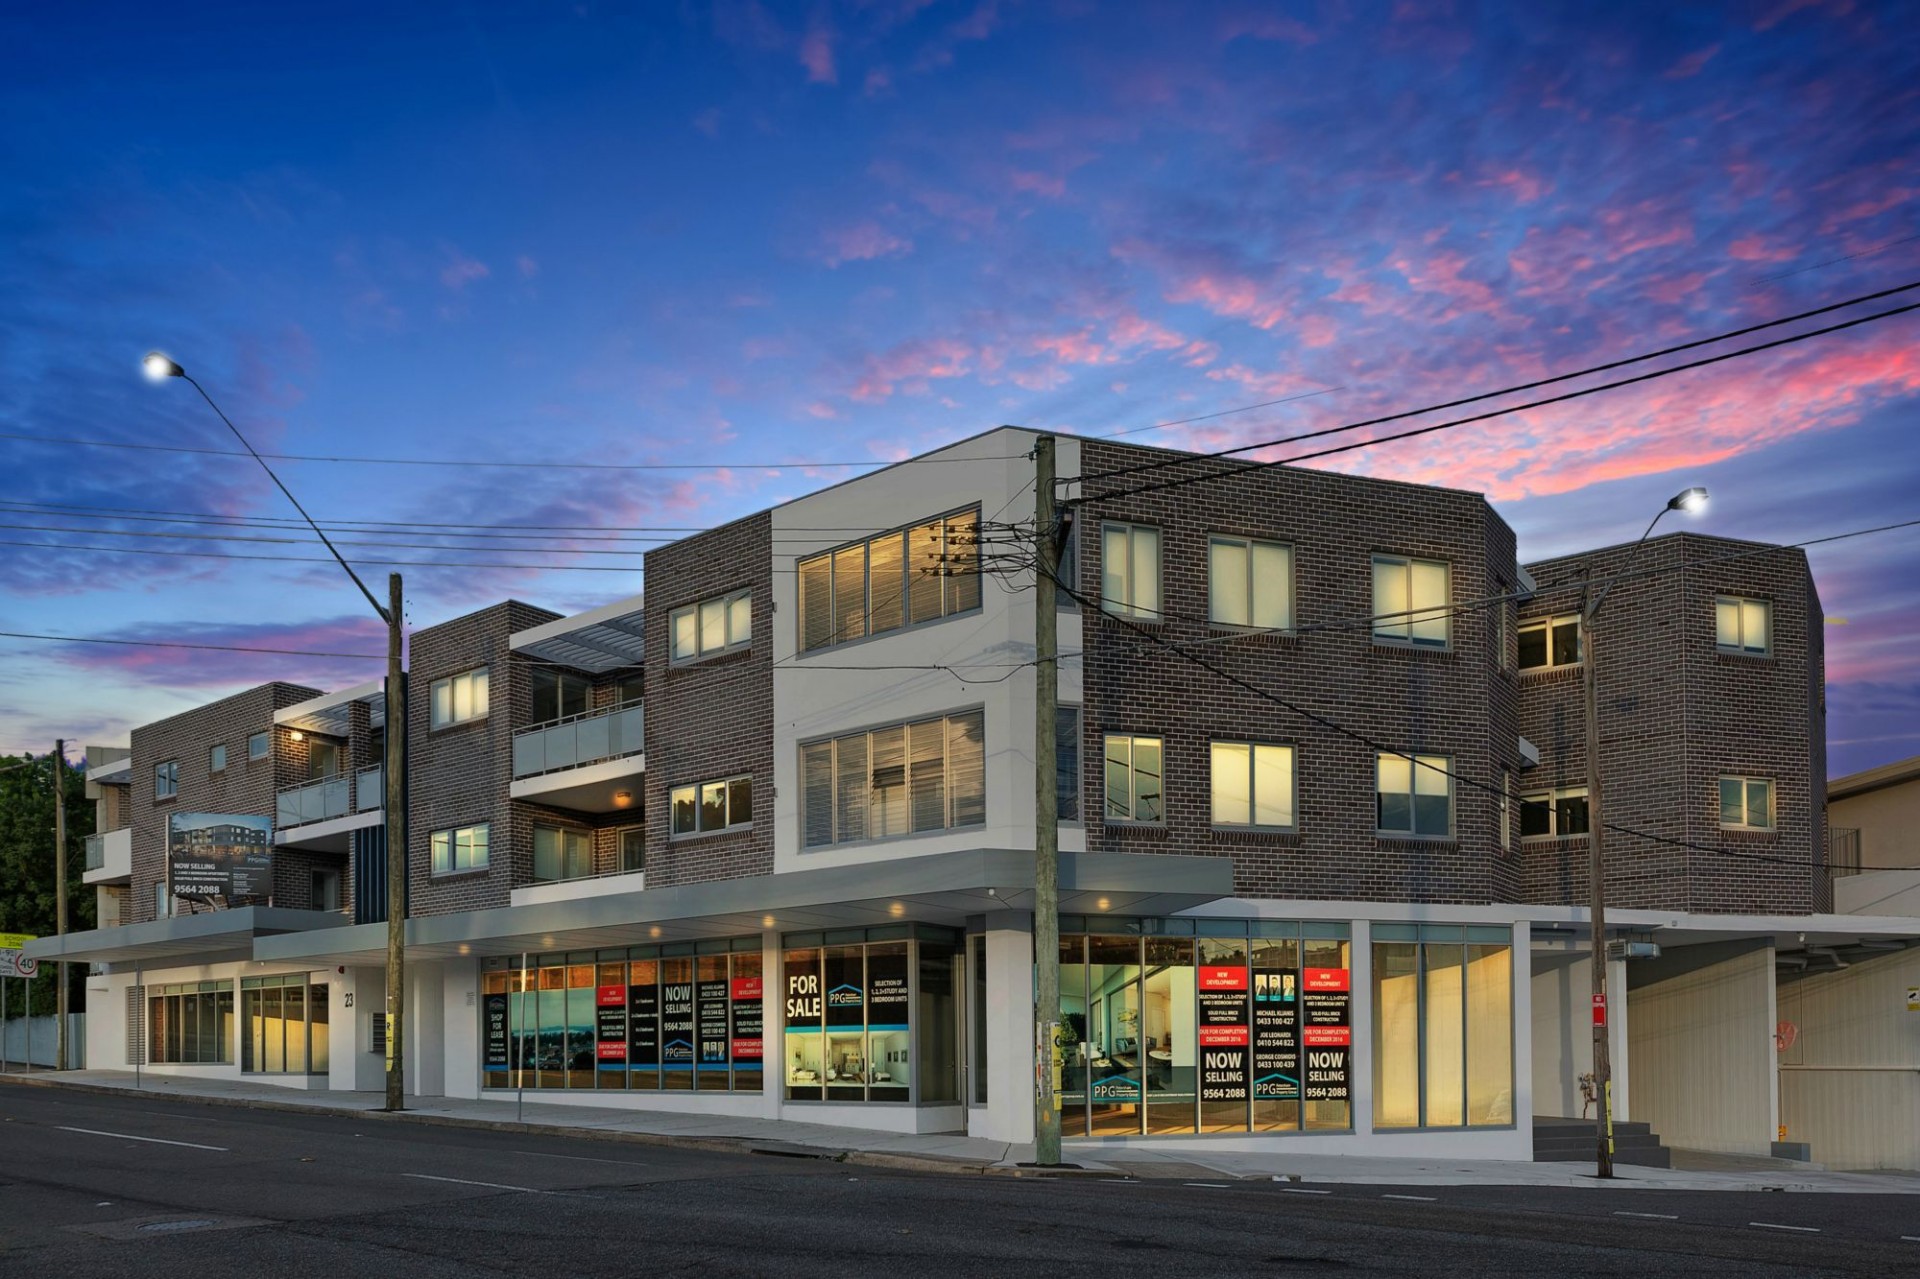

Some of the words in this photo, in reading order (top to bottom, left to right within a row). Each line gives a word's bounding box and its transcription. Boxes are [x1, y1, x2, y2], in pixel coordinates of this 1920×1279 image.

[174, 885, 196, 893] 9564
[20, 959, 33, 969] 40
[789, 975, 818, 994] FOR
[666, 986, 690, 1001] NOW
[830, 993, 846, 1003] PPG
[345, 993, 353, 1007] 23
[665, 1003, 691, 1014] SELLING
[787, 998, 821, 1017] SALE
[664, 1022, 678, 1031] 9564
[679, 1022, 692, 1030] 2088
[665, 1048, 678, 1057] PPG
[1206, 1053, 1242, 1068] NOW
[1309, 1052, 1343, 1068] NOW
[1206, 1072, 1242, 1082] SELLING
[1309, 1071, 1344, 1081] SELLING
[1094, 1086, 1115, 1097] PPG
[1203, 1089, 1224, 1098] 9564
[1225, 1089, 1246, 1098] 2088
[1256, 1084, 1276, 1094] PPG
[1307, 1088, 1326, 1097] 9564
[1328, 1088, 1347, 1097] 2088
